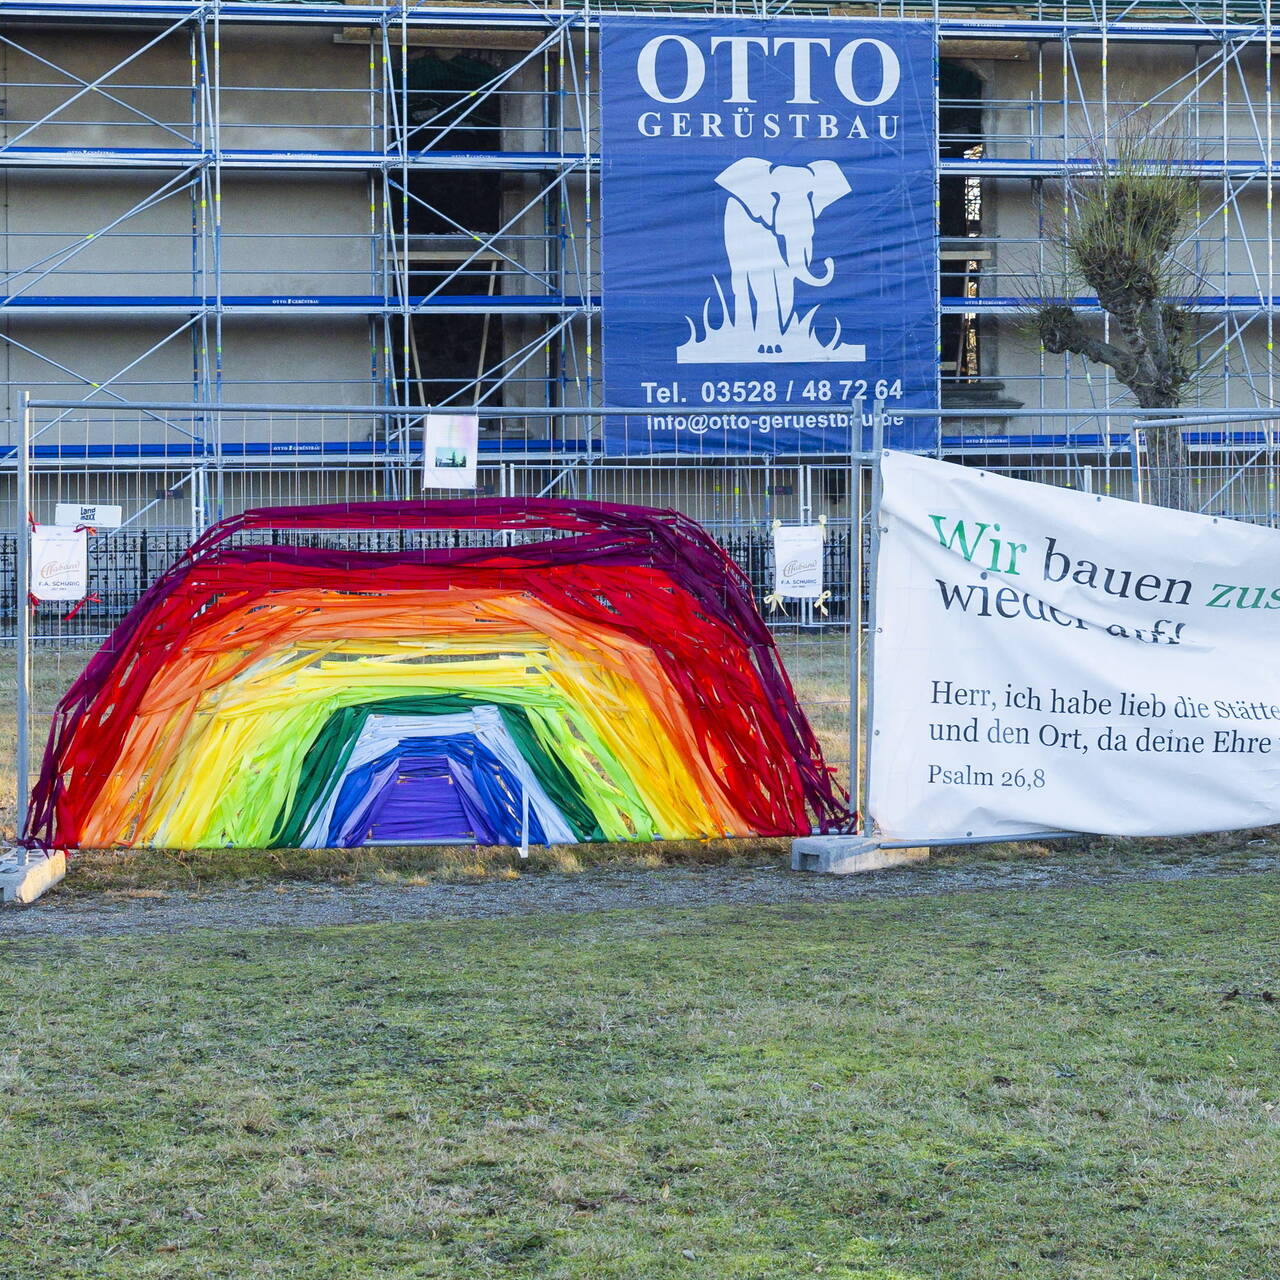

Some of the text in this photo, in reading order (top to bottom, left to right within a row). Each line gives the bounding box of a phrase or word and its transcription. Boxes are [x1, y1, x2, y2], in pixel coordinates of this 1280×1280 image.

[637, 35, 900, 106] OTTO
[637, 107, 899, 140] GERÜSTBAU
[641, 379, 903, 403] Tel. 03528 / 48 72 64
[647, 413, 904, 434] info@otto-geruestbude
[928, 514, 1028, 576] Wir
[1043, 536, 1193, 605] bauen
[930, 680, 997, 711] Herr,
[1004, 683, 1042, 712] ich
[1050, 688, 1112, 715] habe
[1119, 692, 1166, 718] lieb
[1174, 695, 1210, 719] die
[1214, 699, 1280, 721] Stätte
[929, 717, 979, 743] und
[987, 718, 1030, 745] den
[1038, 723, 1089, 755] Ort,
[1097, 726, 1128, 752] da
[1135, 727, 1204, 753] deine
[1212, 730, 1272, 754] Ehre
[927, 764, 1046, 792] Psalm 26,8
